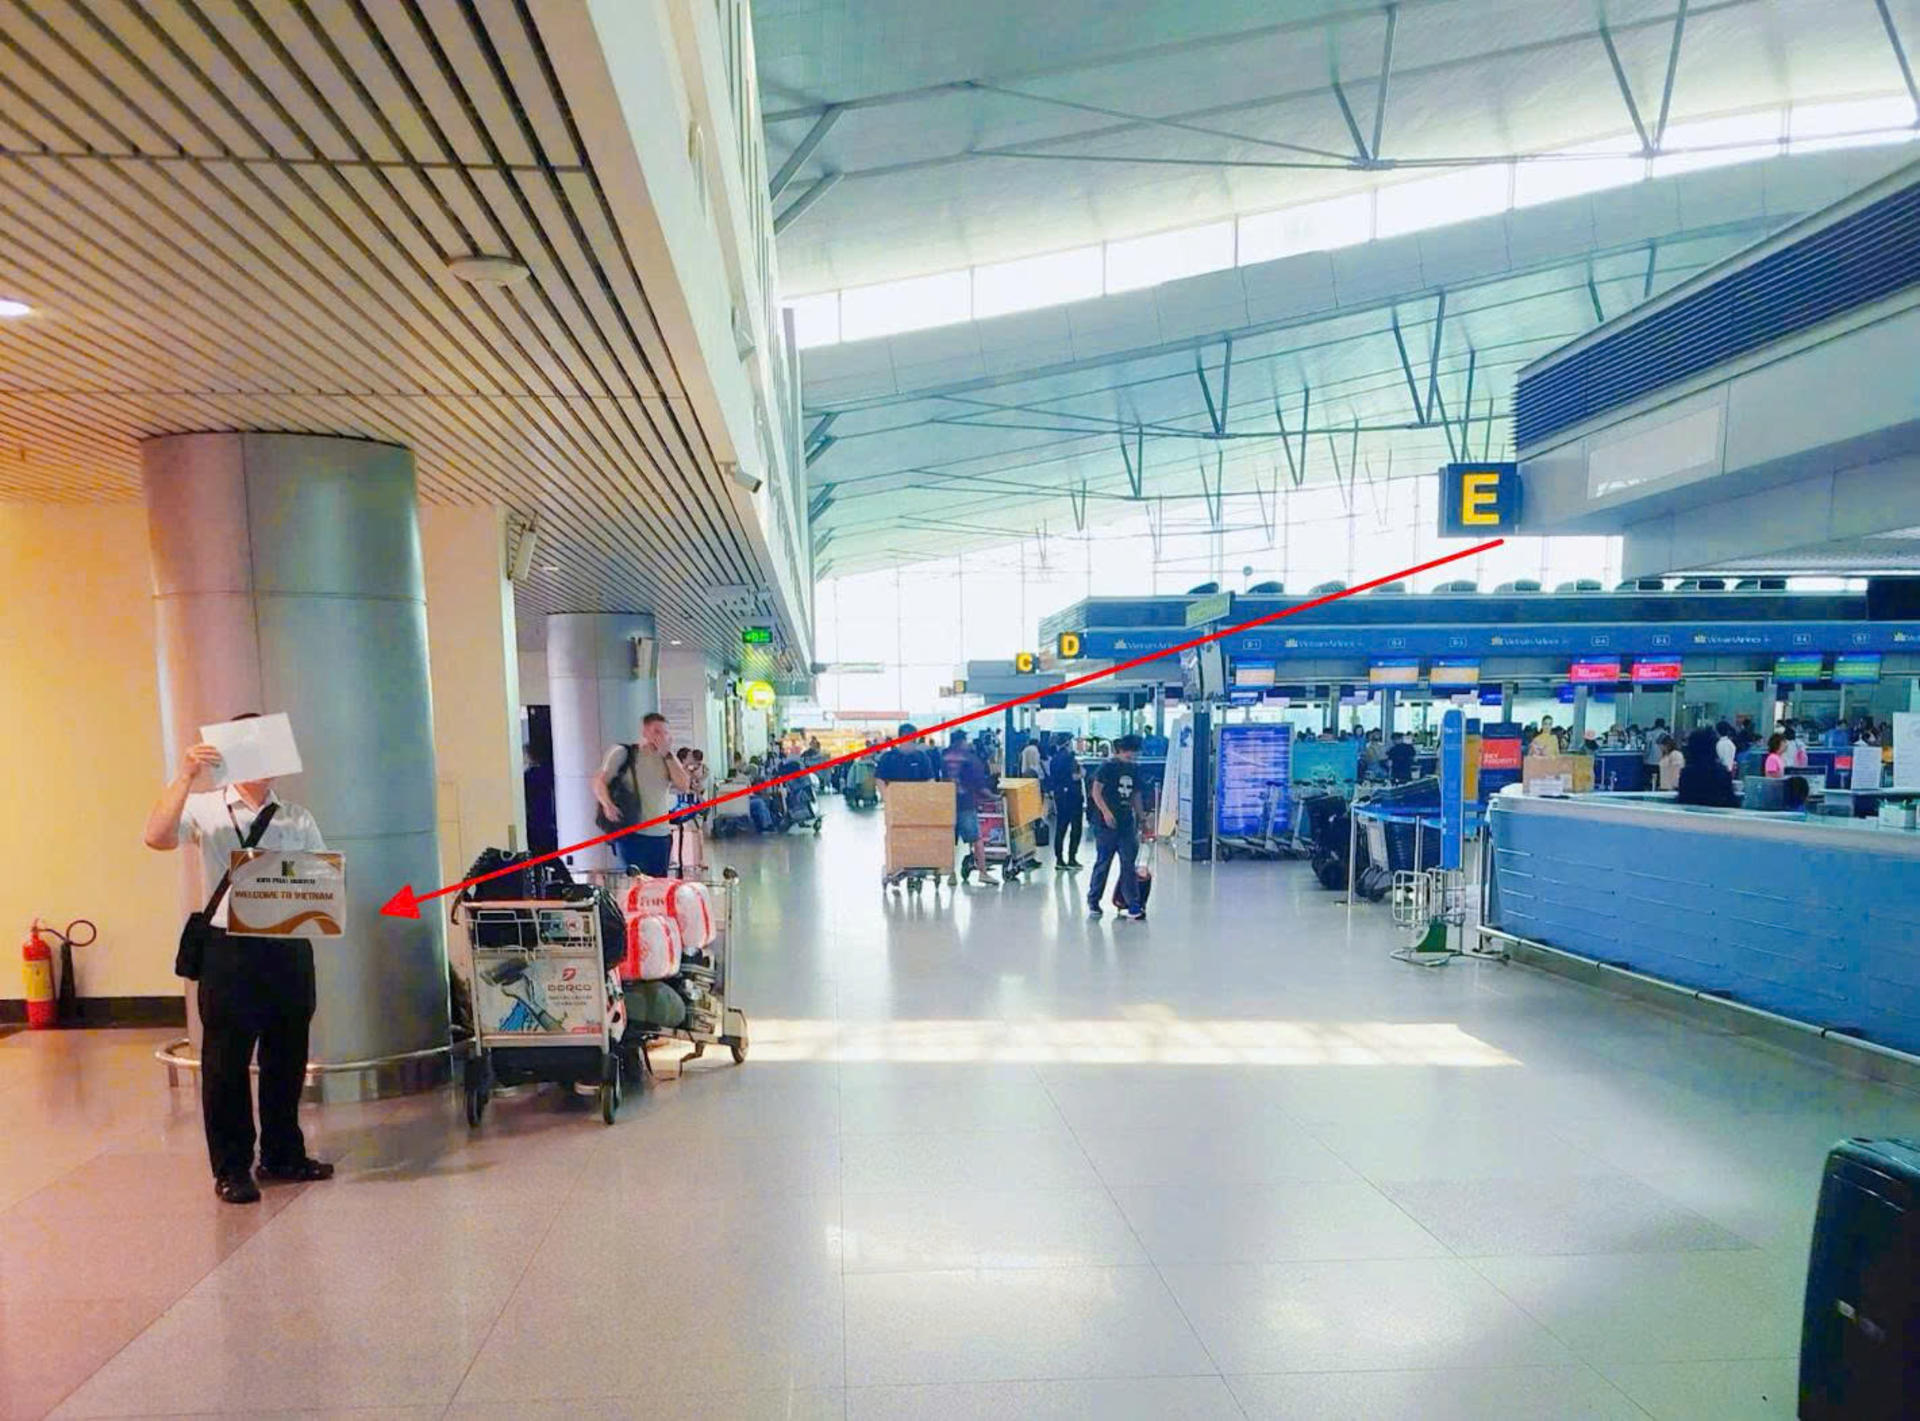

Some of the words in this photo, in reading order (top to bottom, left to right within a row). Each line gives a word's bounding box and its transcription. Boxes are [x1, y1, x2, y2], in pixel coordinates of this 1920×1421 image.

[1461, 472, 1501, 526] E
[1061, 633, 1080, 657] D
[1018, 652, 1033, 672] C
[234, 890, 278, 900] WELCOME
[281, 891, 293, 900] TO
[293, 891, 335, 901] VIETNAM
